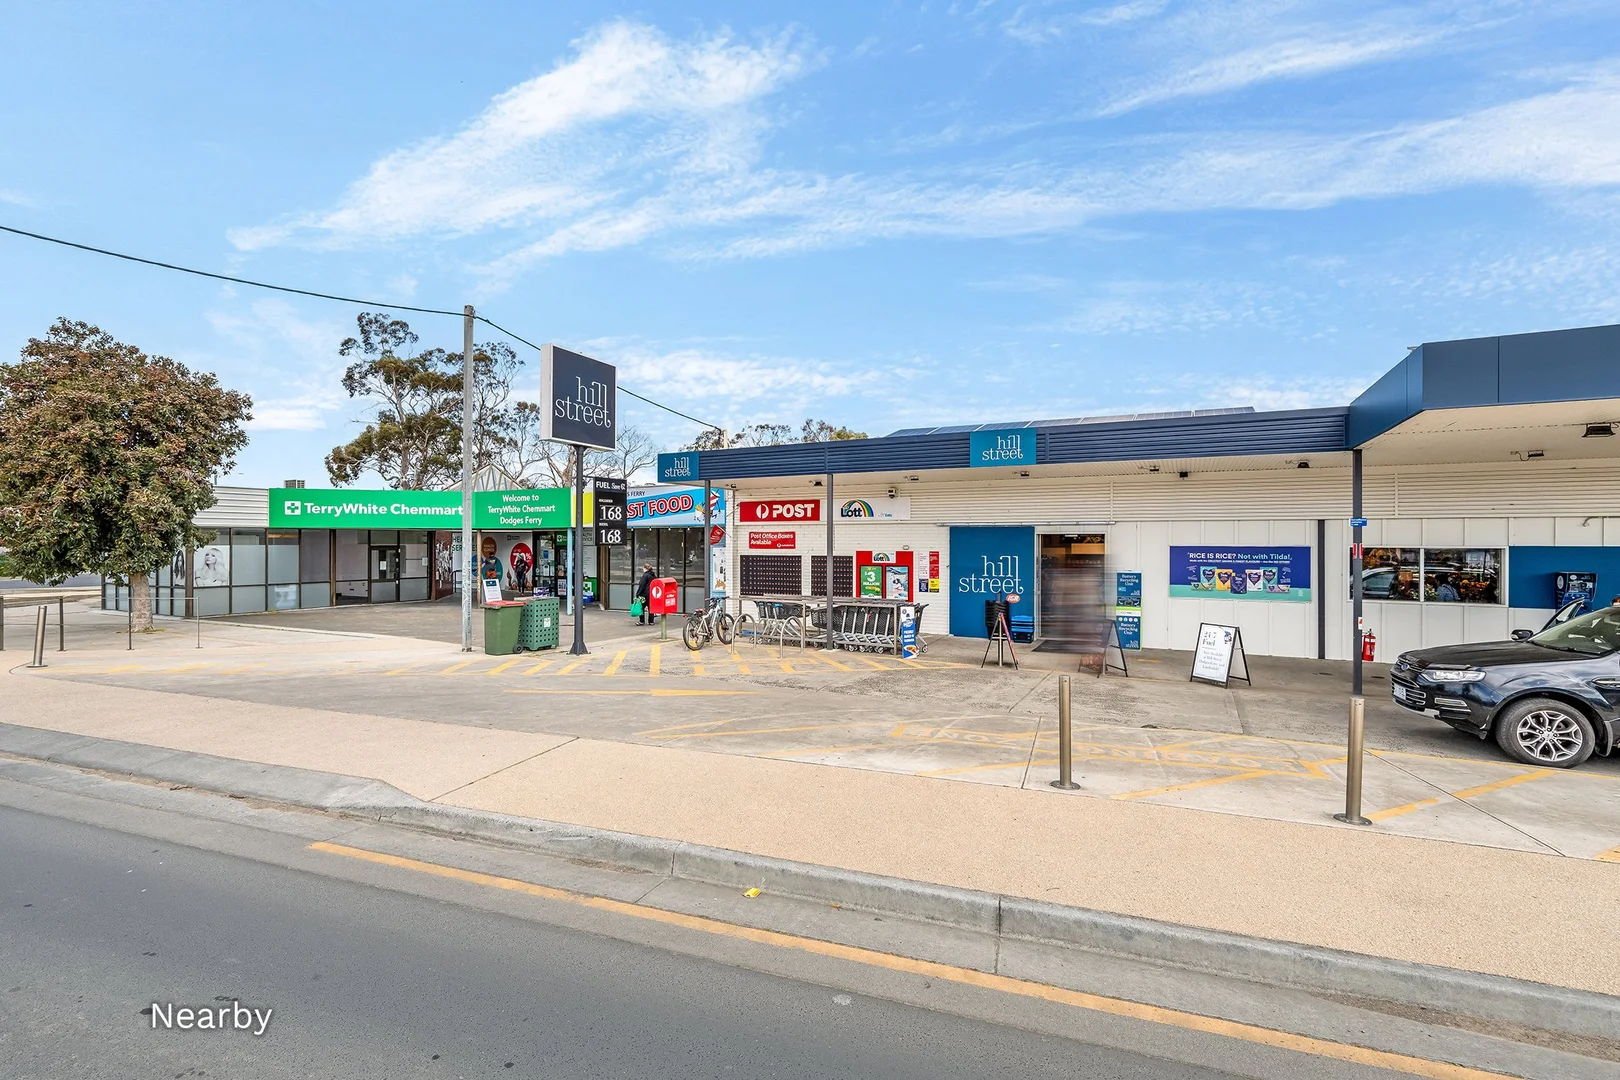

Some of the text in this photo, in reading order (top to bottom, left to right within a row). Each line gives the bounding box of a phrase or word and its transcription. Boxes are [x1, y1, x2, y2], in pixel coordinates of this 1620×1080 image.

[576, 376, 608, 408] hill
[554, 397, 612, 428] street
[997, 435, 1020, 450] hill
[982, 446, 1024, 460] street
[674, 457, 690, 470] hill
[664, 466, 690, 478] street
[502, 494, 530, 502] Welcome
[304, 503, 463, 517] TerryWhite Chemmart
[488, 504, 556, 514] TerryWhite Chemmart
[601, 506, 622, 520] 168
[626, 494, 693, 518] ST FOOD
[772, 504, 815, 518] POST
[841, 508, 862, 518] Lott
[500, 516, 542, 525] Dodges Ferry
[600, 529, 621, 543] 168
[982, 555, 1018, 578] hill
[958, 574, 1024, 595] street
